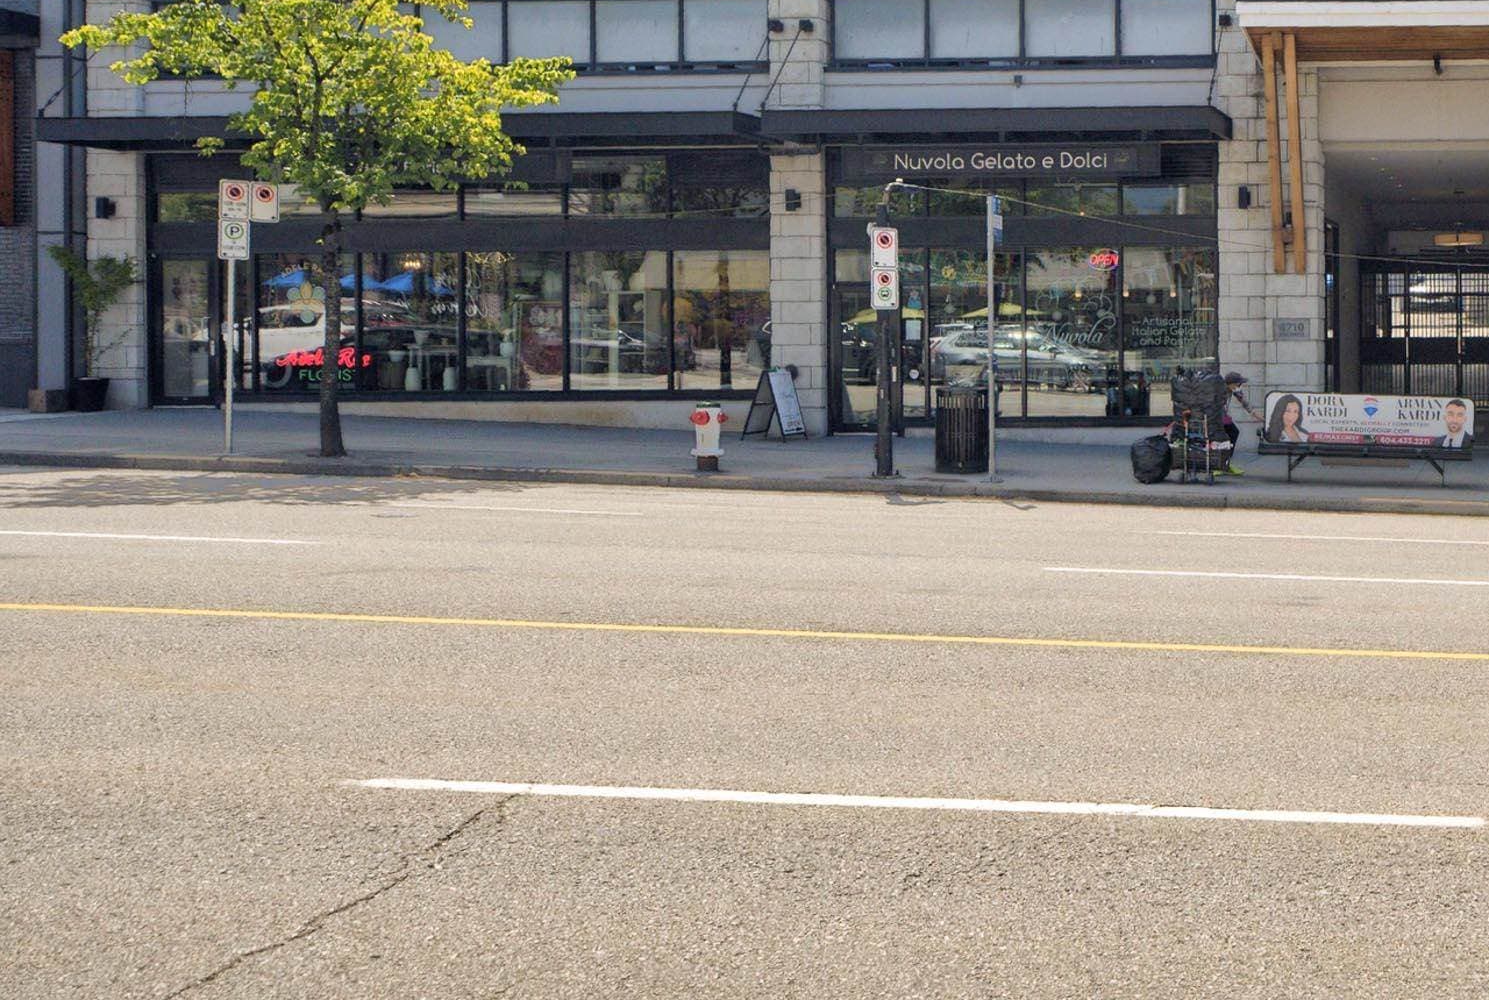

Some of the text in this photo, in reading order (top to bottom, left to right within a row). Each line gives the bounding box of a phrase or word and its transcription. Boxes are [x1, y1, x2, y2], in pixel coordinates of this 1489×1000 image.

[894, 151, 1107, 169] Nuvola Gelato e Dolci
[1089, 254, 1119, 266] OPEN
[1142, 317, 1194, 327] Artisanal
[1140, 336, 1161, 346] and
[1307, 396, 1344, 406] DORA
[1396, 398, 1442, 408] ARMAN
[1307, 407, 1348, 417] KARDI
[1397, 410, 1441, 421] KARDI
